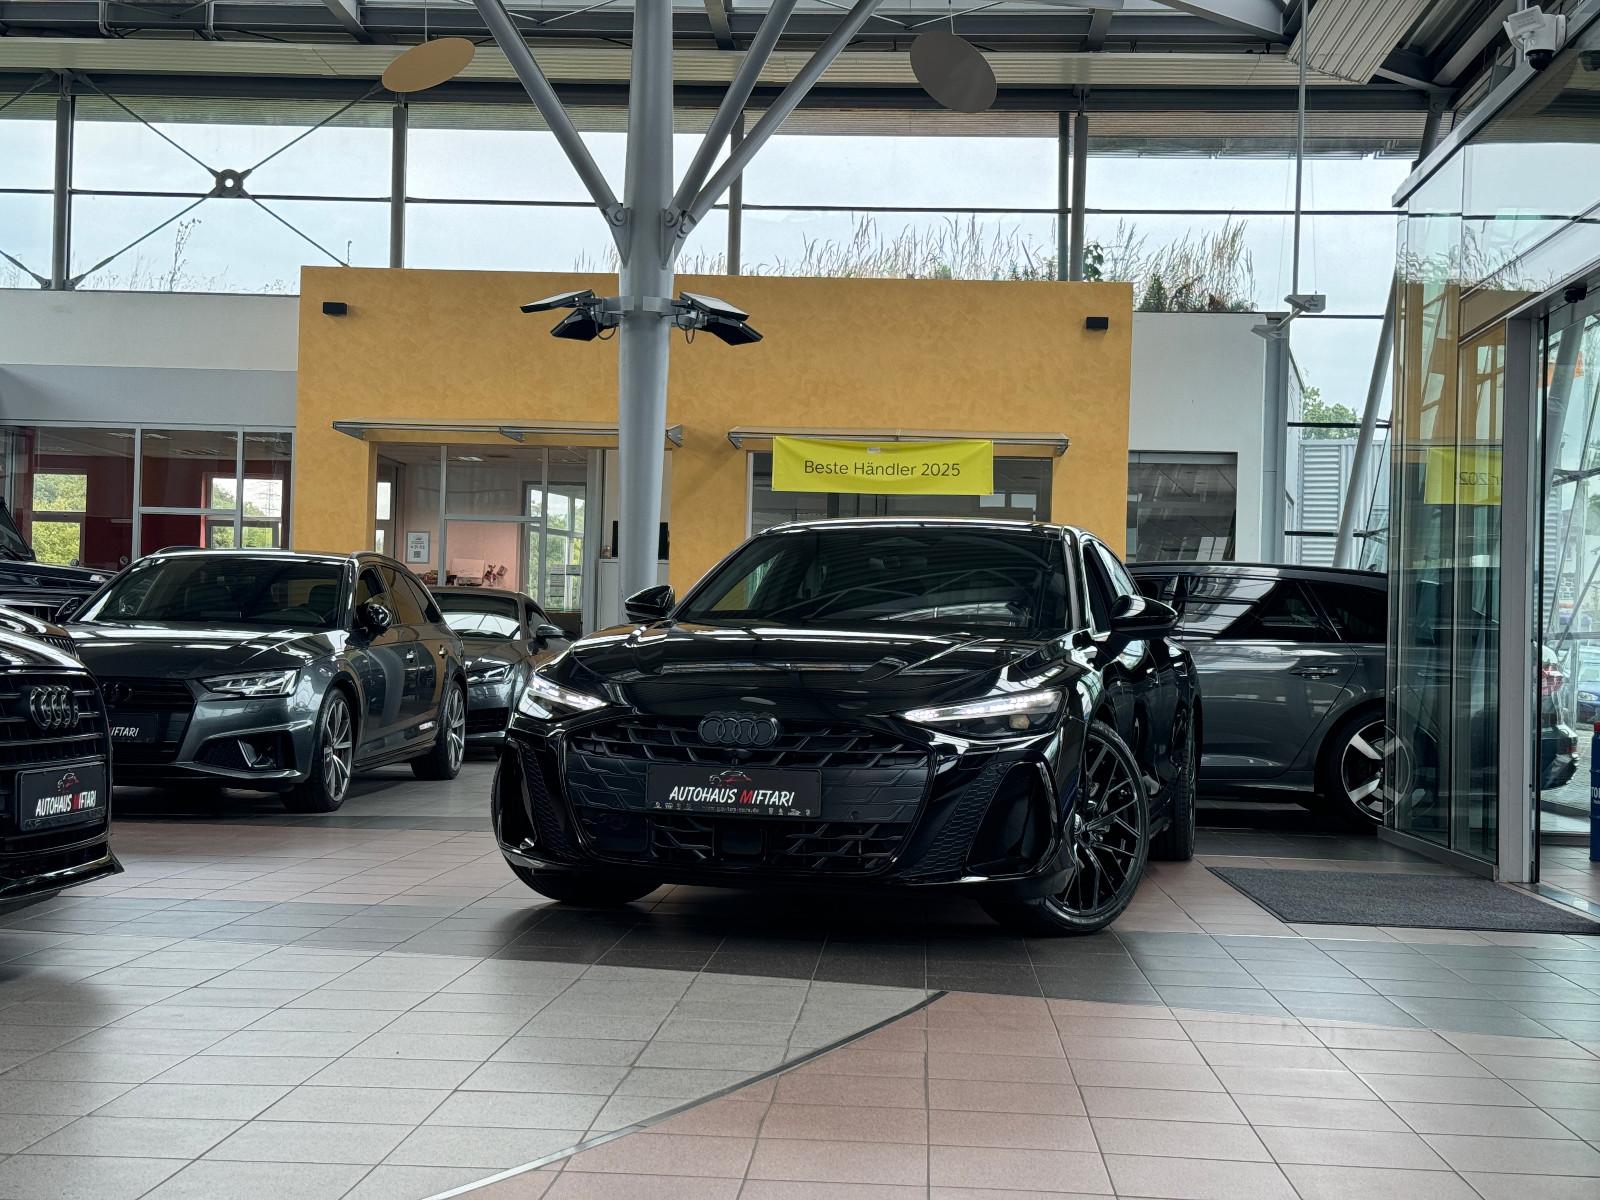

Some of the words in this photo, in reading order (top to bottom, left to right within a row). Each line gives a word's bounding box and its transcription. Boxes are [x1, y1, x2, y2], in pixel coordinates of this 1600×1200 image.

[804, 460, 849, 475] Beste
[854, 462, 917, 477] Händler
[920, 463, 961, 477] 2025
[109, 726, 139, 737] IFTARI
[35, 794, 72, 816] AUTOHAUS
[72, 790, 97, 811] MIFTARI
[669, 786, 737, 803] AUTOHAUS
[739, 789, 795, 807] MIFTARI
